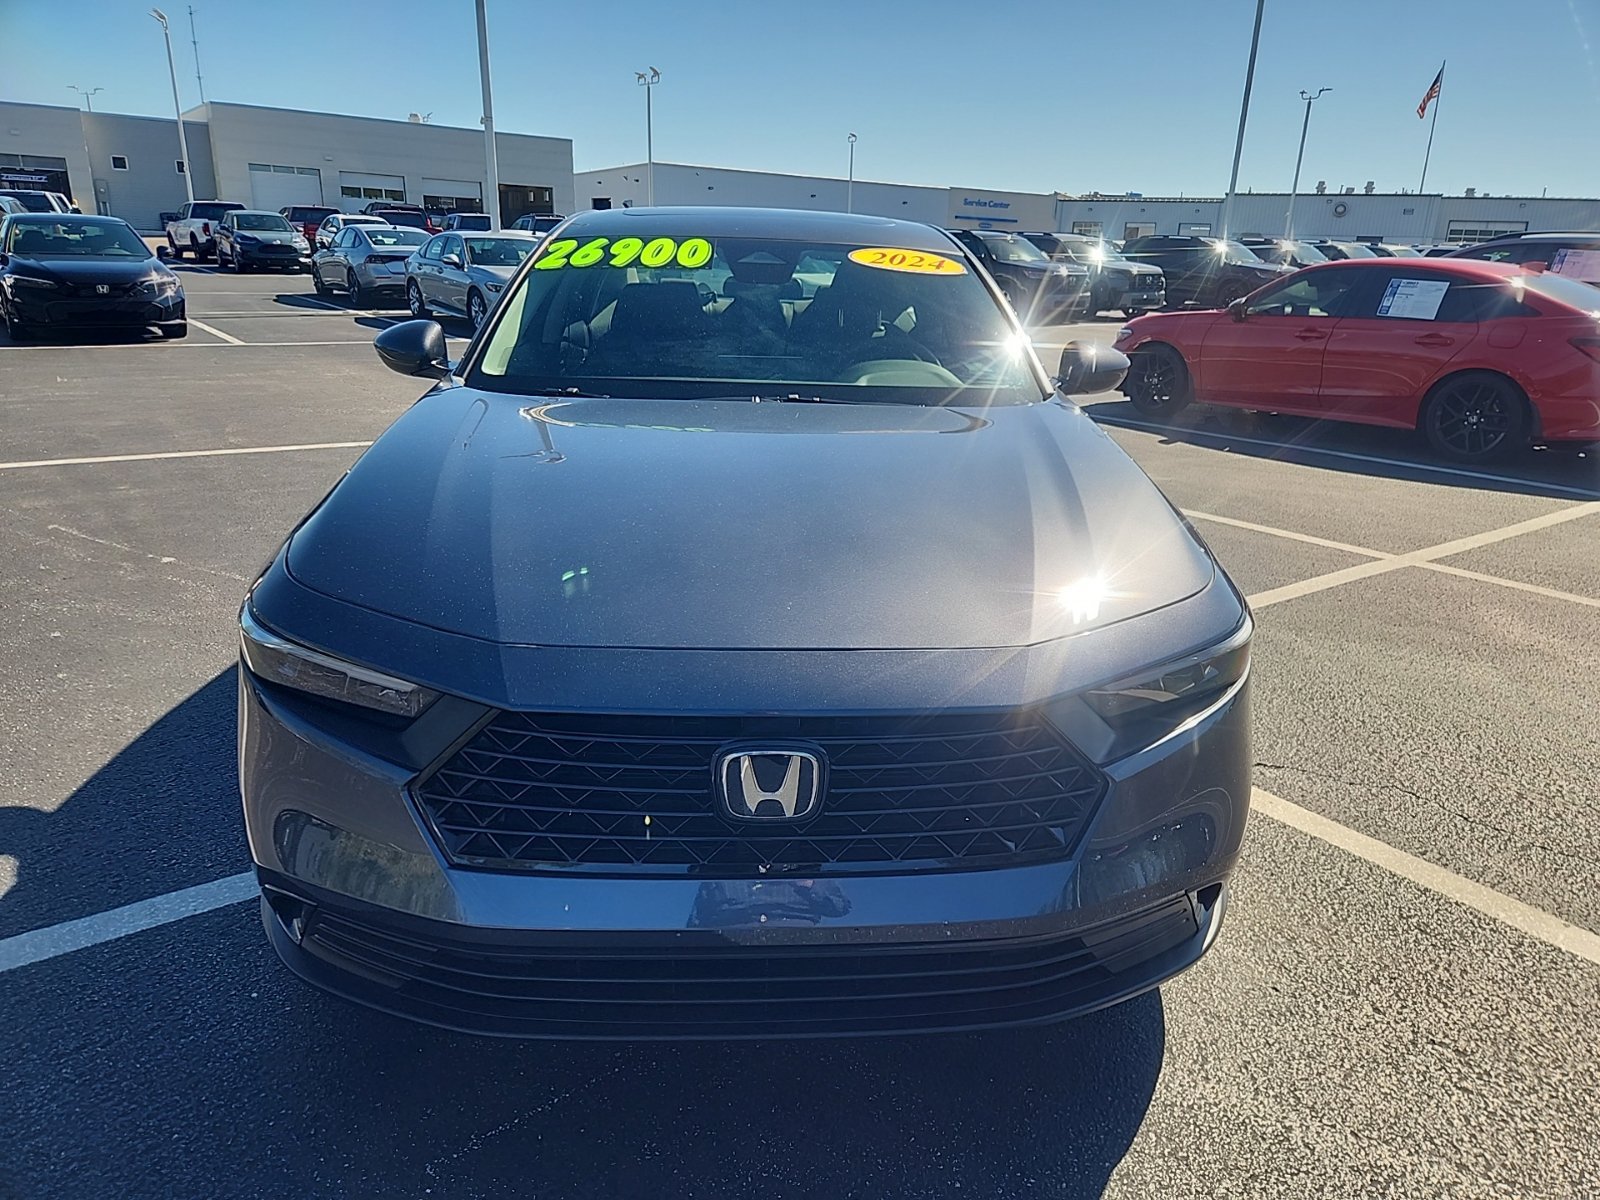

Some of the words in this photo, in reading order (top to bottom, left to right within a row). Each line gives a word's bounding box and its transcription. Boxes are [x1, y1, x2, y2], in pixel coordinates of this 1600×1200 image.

[963, 198, 987, 208] Service
[988, 200, 1010, 209] Center
[534, 238, 712, 270] 26900
[868, 252, 946, 270] 2024
